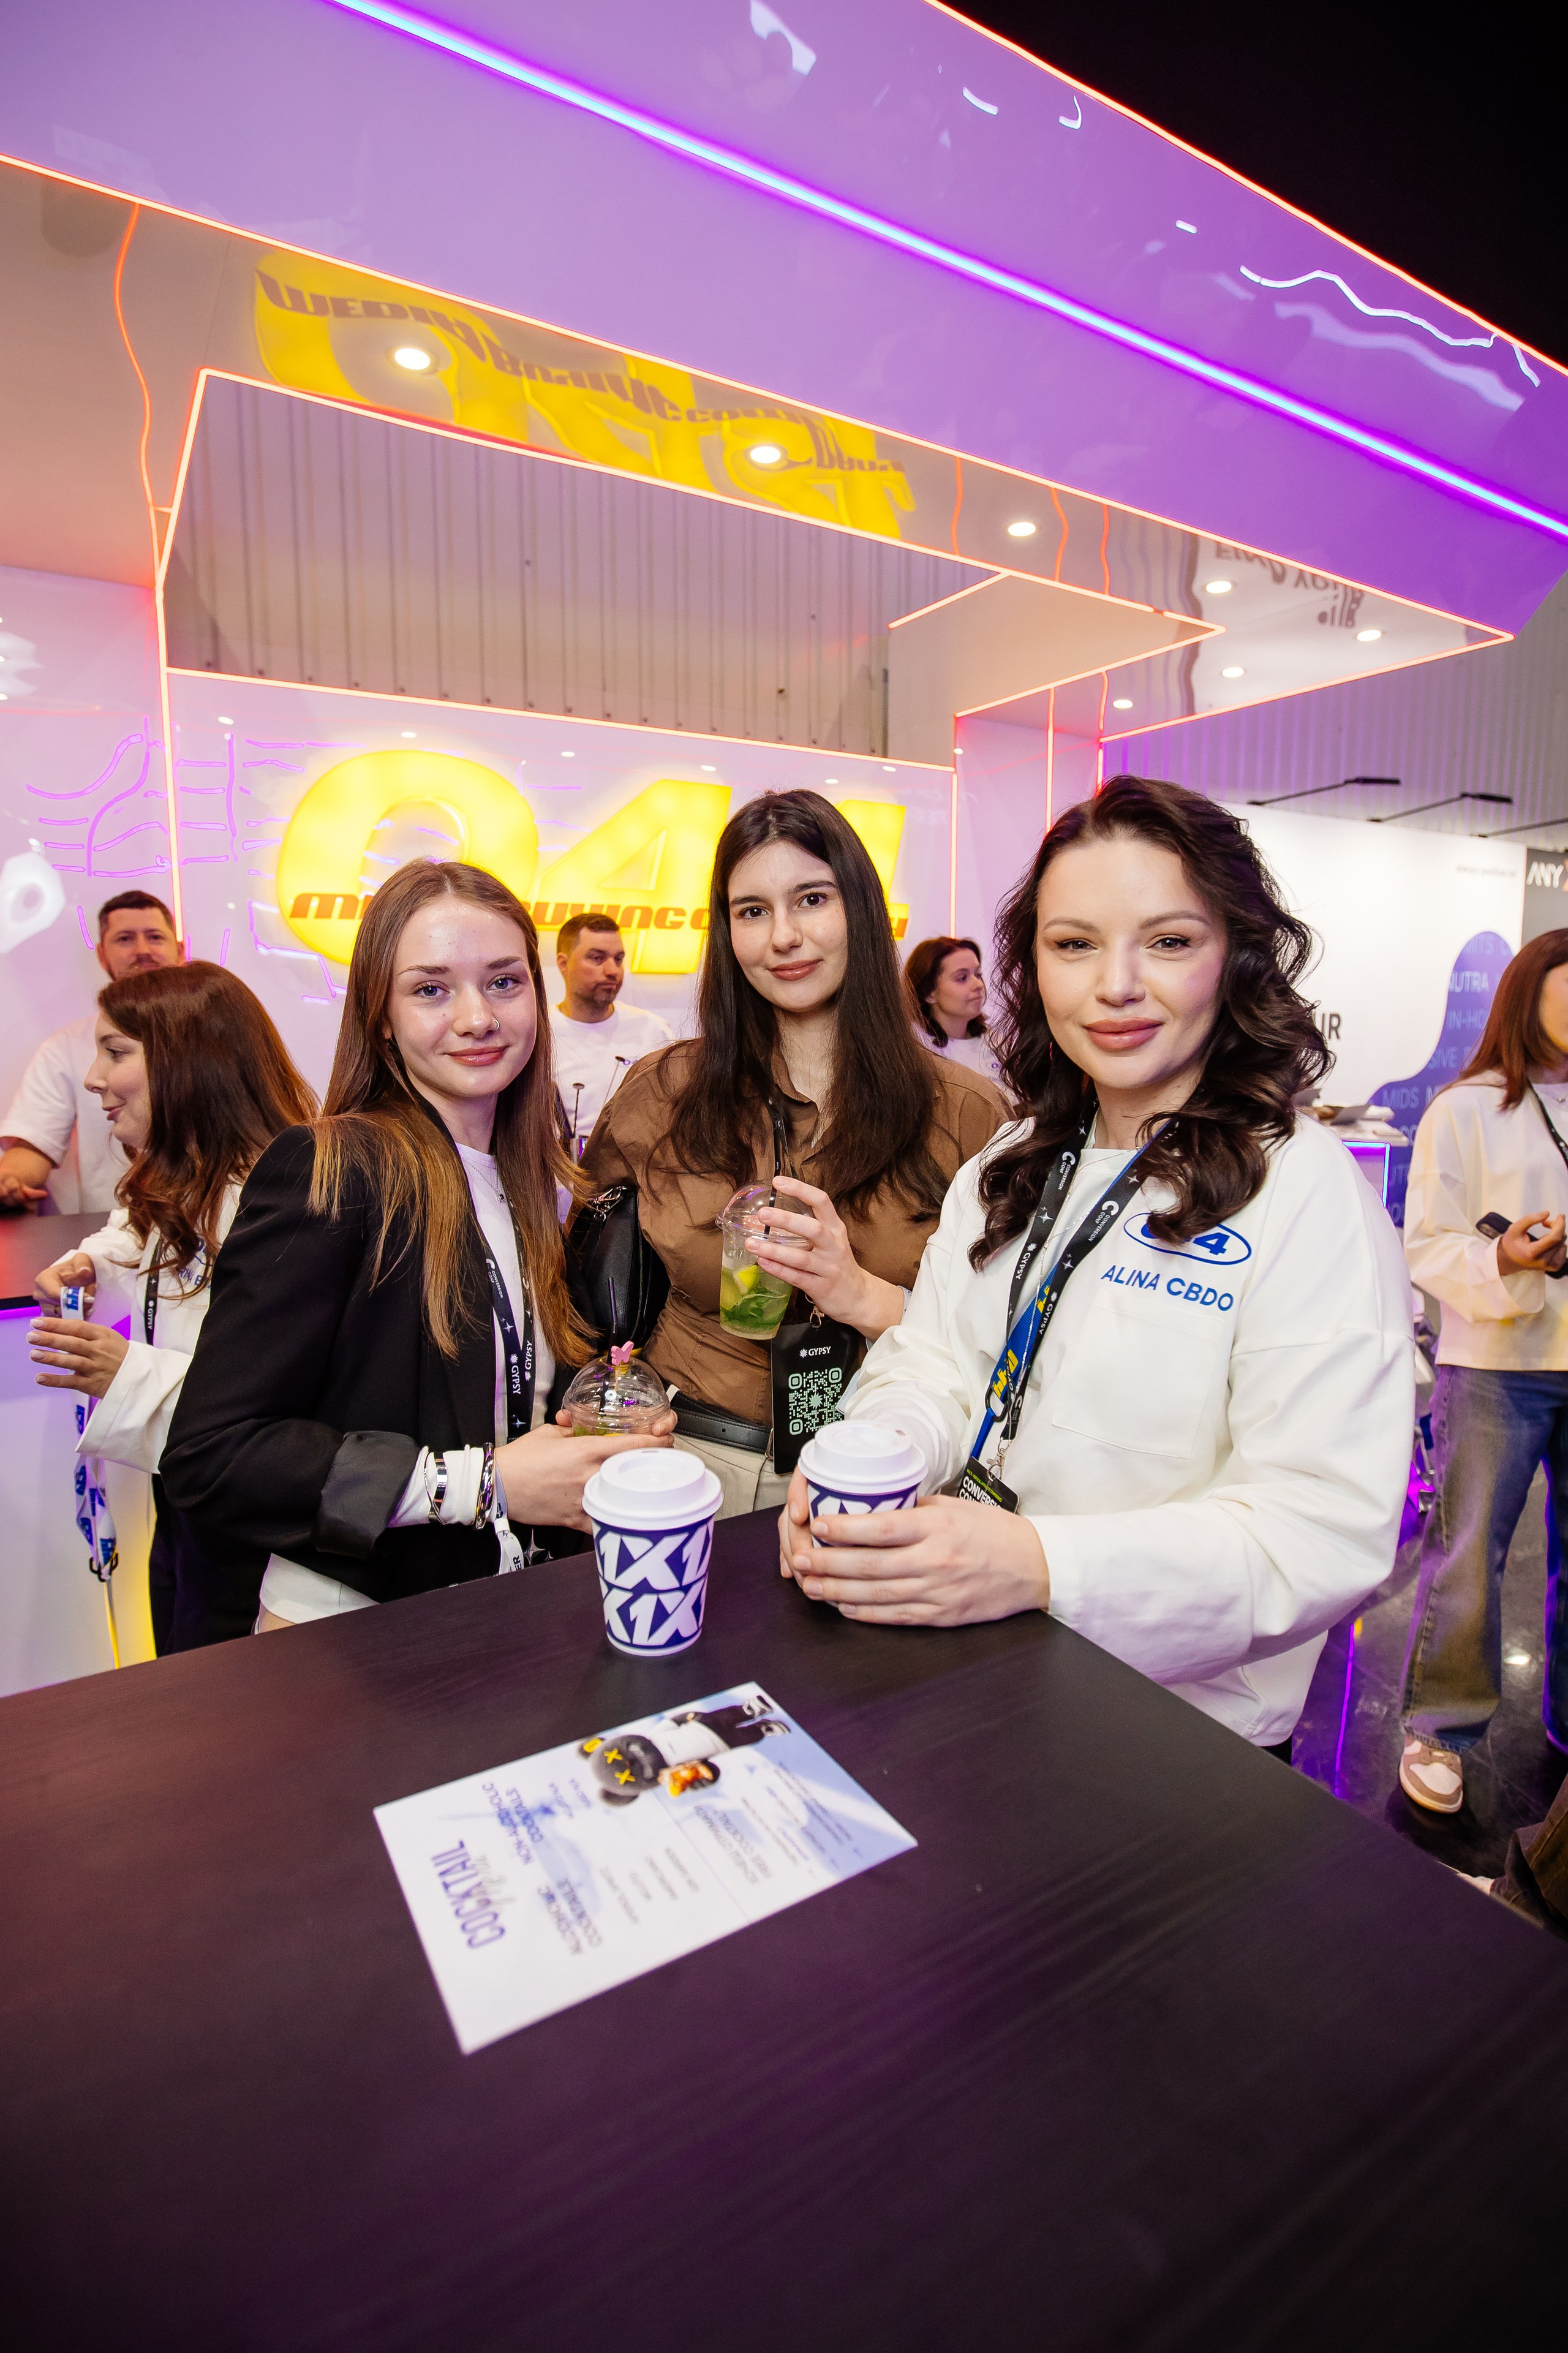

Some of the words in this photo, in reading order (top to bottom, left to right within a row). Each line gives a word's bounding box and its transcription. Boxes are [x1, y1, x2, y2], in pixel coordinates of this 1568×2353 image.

[1058, 1163, 1071, 1190] CONVERSION
[1088, 1214, 1110, 1242] CONVERSION
[1095, 1211, 1106, 1225] CONF
[1016, 1252, 1031, 1280] GYPSY
[491, 1270, 503, 1299] CONVERSION
[1101, 1265, 1161, 1291] ALINA
[1166, 1277, 1234, 1312] CBDO
[1039, 1304, 1053, 1335] GYPSY
[525, 1340, 533, 1370] GYPSY
[808, 1346, 832, 1356] GYPSY
[510, 1365, 521, 1395] GYPSY
[963, 1476, 1002, 1508] CONVERS
[427, 1838, 510, 1952] COCKTAIL
